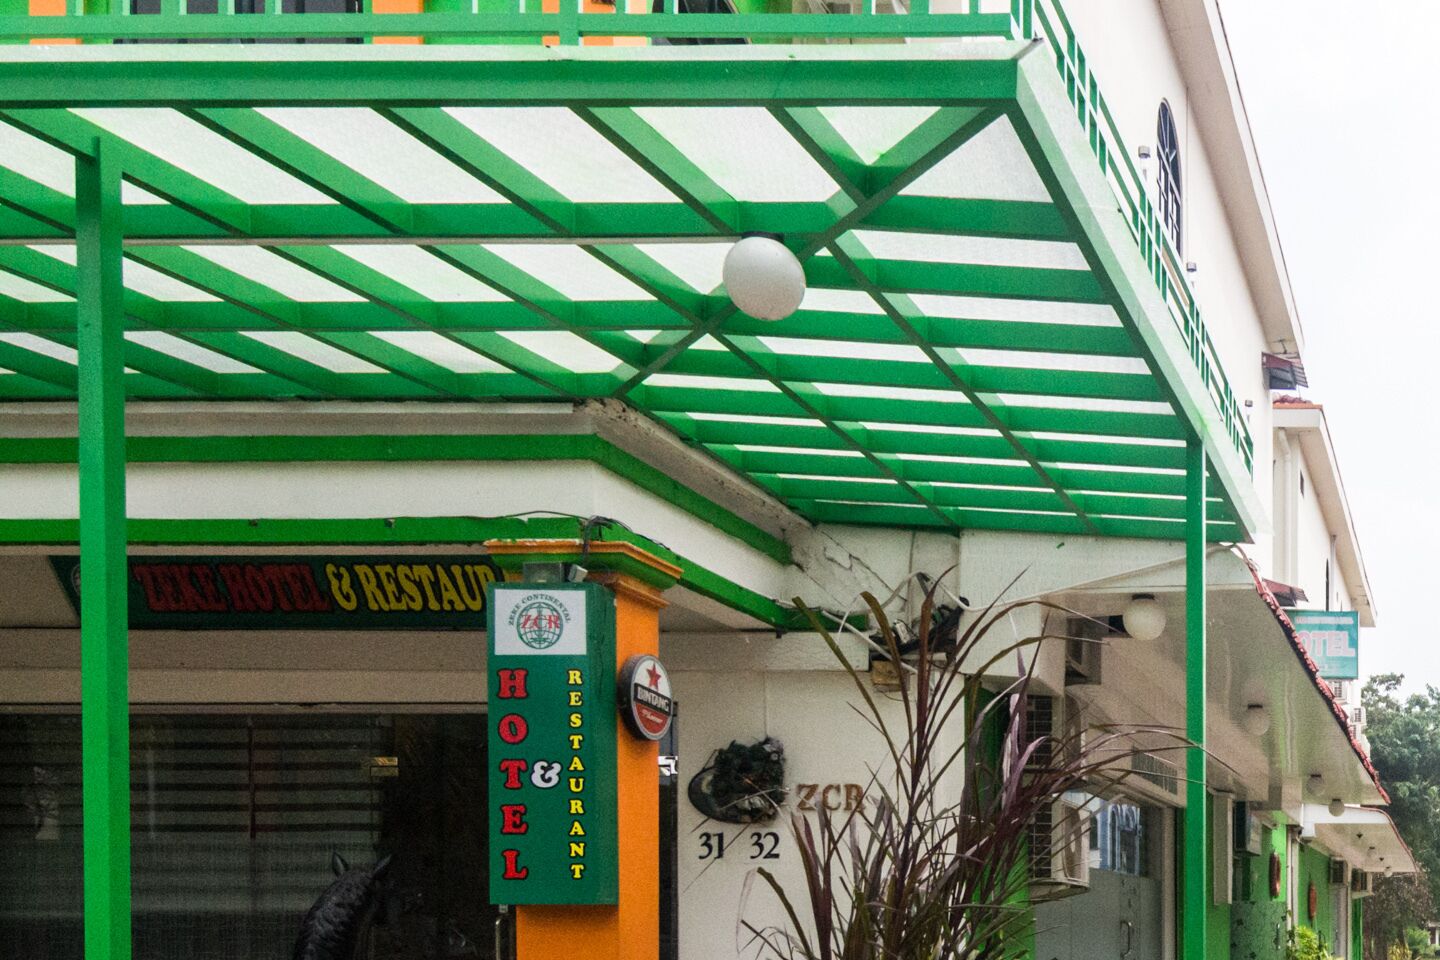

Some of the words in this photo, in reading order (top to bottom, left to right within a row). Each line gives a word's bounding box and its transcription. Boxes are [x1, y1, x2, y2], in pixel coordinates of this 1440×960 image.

[217, 563, 333, 613] HOTEL
[325, 563, 357, 611] &
[521, 593, 571, 624] CONTINENTAL
[1297, 631, 1356, 657] OTEL
[497, 669, 528, 879] HOTEL
[530, 760, 562, 789] &
[567, 669, 585, 879] RESTAURANT
[796, 783, 867, 812] ZCR
[698, 832, 724, 860] 31
[750, 832, 780, 860] 32
